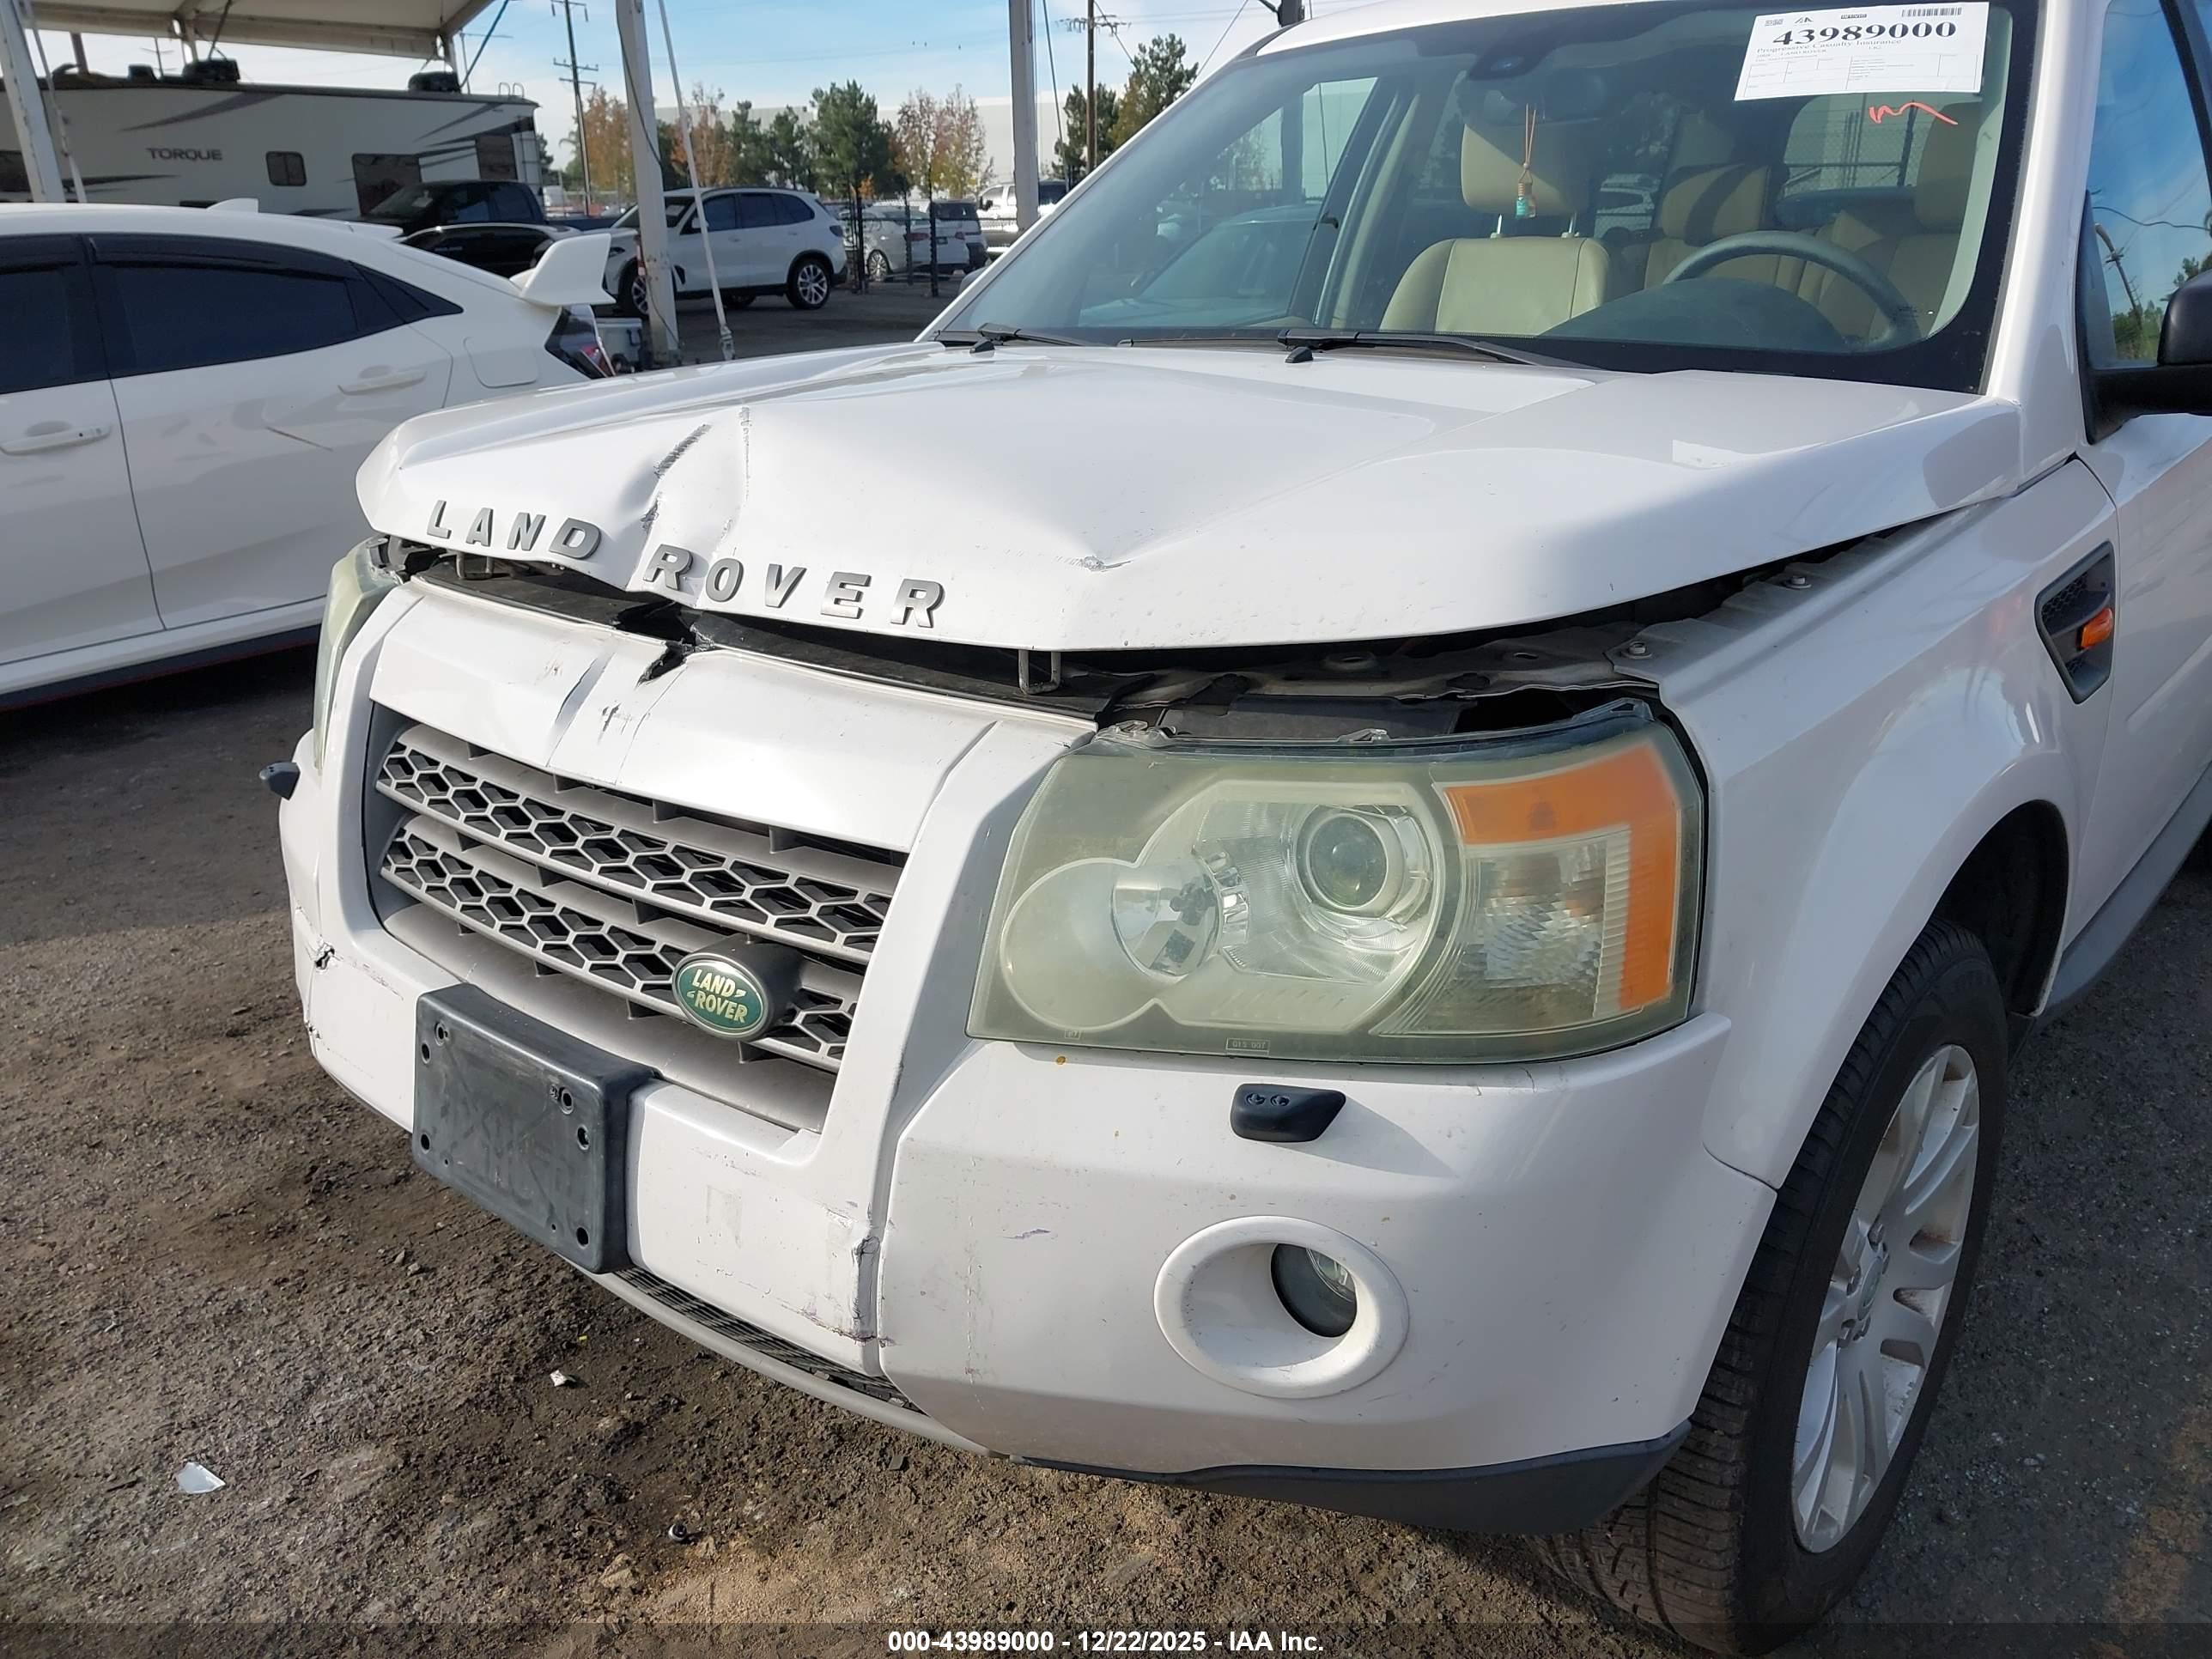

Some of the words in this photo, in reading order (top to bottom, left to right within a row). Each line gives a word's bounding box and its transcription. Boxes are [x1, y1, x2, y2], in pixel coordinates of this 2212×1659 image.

[1772, 21, 1957, 46] 43989000
[1756, 45, 1810, 54] Progressive
[146, 148, 223, 161] TORQUE
[426, 499, 603, 560] LAND
[642, 543, 946, 629] ROVER
[691, 969, 737, 998] LAND
[694, 989, 749, 1024] ROVER
